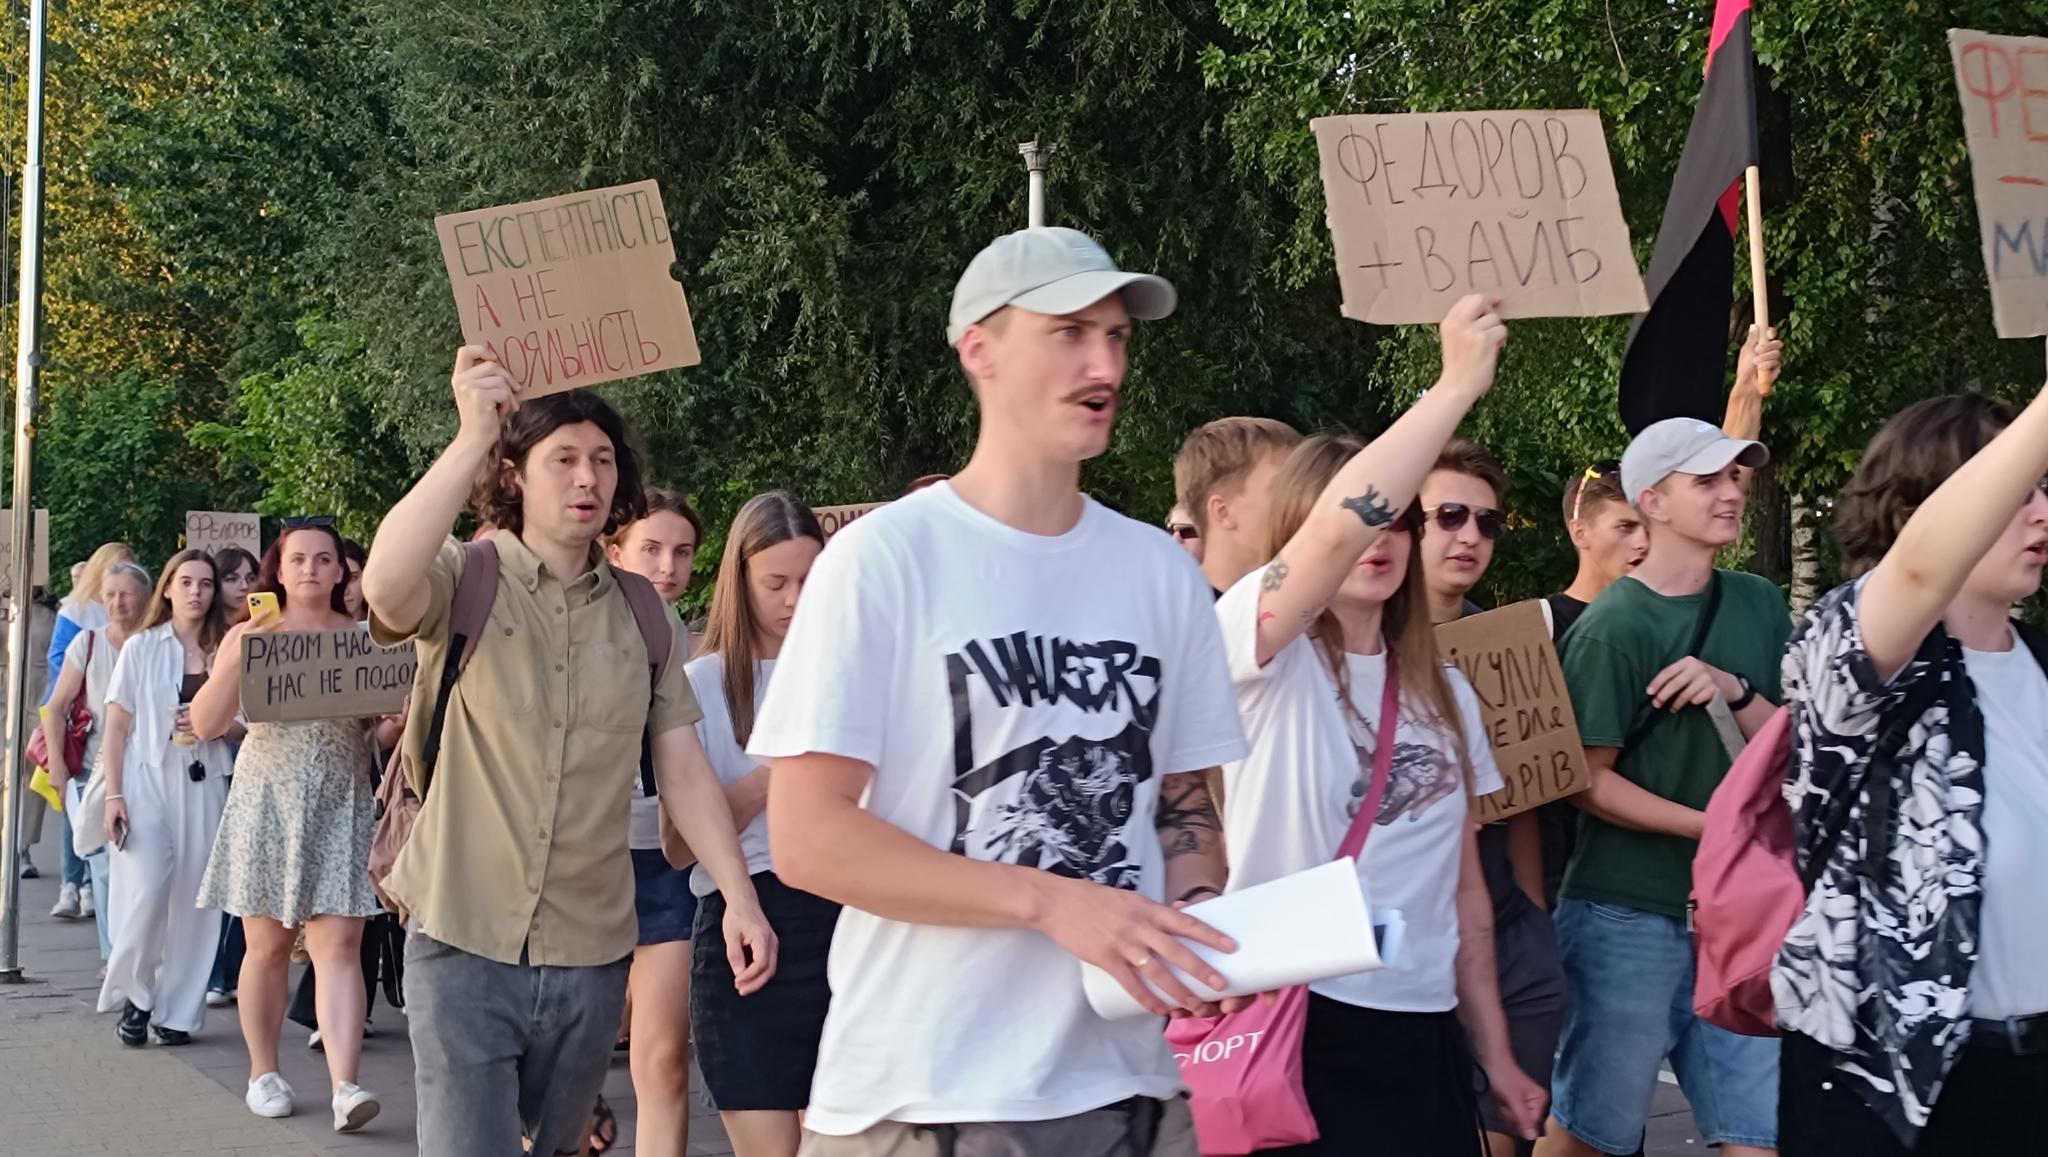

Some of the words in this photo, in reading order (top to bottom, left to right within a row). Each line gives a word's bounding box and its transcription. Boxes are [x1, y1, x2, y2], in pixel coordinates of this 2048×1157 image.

[1338, 117, 1587, 205] ФЕДОРОВ
[454, 190, 668, 276] ЕКСПЕРТНІСТЬ
[1993, 217, 2048, 281] М
[476, 284, 501, 331] А
[512, 269, 565, 322] НЕ
[247, 634, 321, 673] РАЗОМ
[333, 631, 372, 660] НАС
[268, 671, 306, 705] НАС
[320, 668, 342, 695] НЕ
[355, 661, 419, 692] ПОДО
